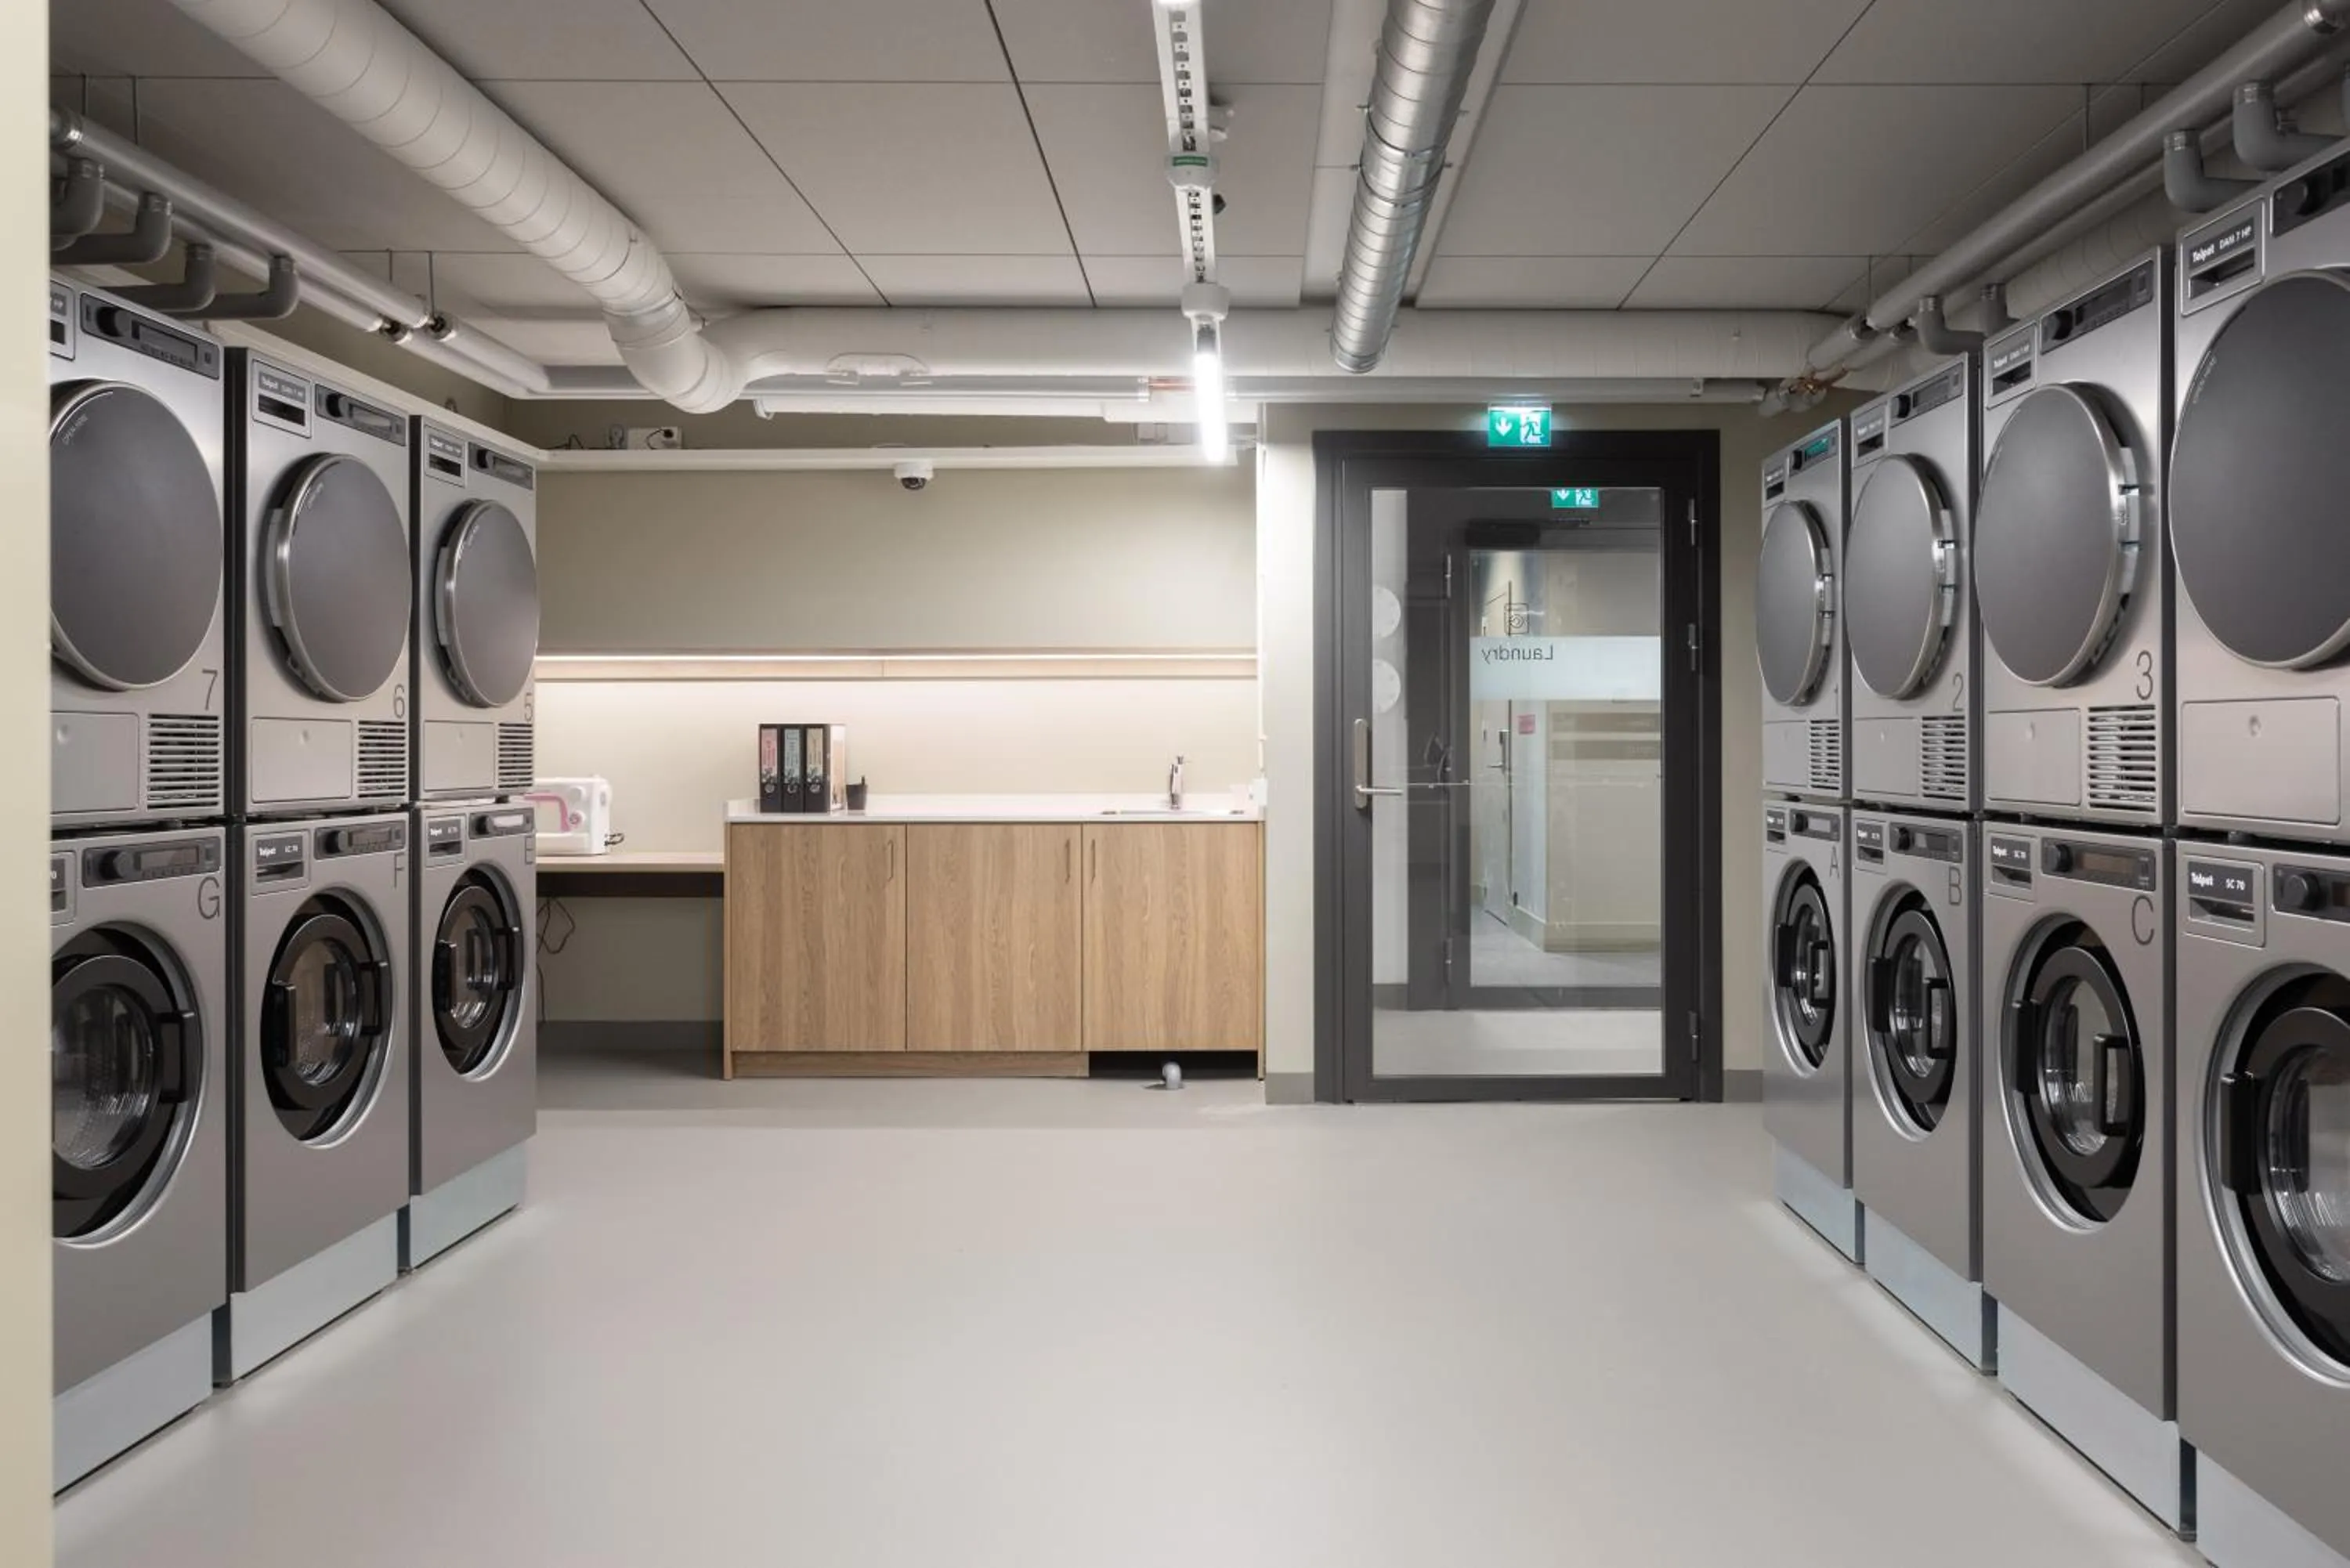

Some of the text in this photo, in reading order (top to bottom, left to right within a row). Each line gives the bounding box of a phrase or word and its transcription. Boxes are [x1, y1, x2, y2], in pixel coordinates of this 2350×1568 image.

[202, 669, 218, 711] 7
[1953, 672, 1965, 712] 2
[2137, 650, 2153, 701] 3
[393, 684, 405, 719] 6
[524, 692, 533, 722] 5
[394, 852, 405, 890] F
[1829, 846, 1840, 879] A
[197, 876, 221, 920] G
[1949, 866, 1962, 906] B
[2131, 895, 2154, 946] C
